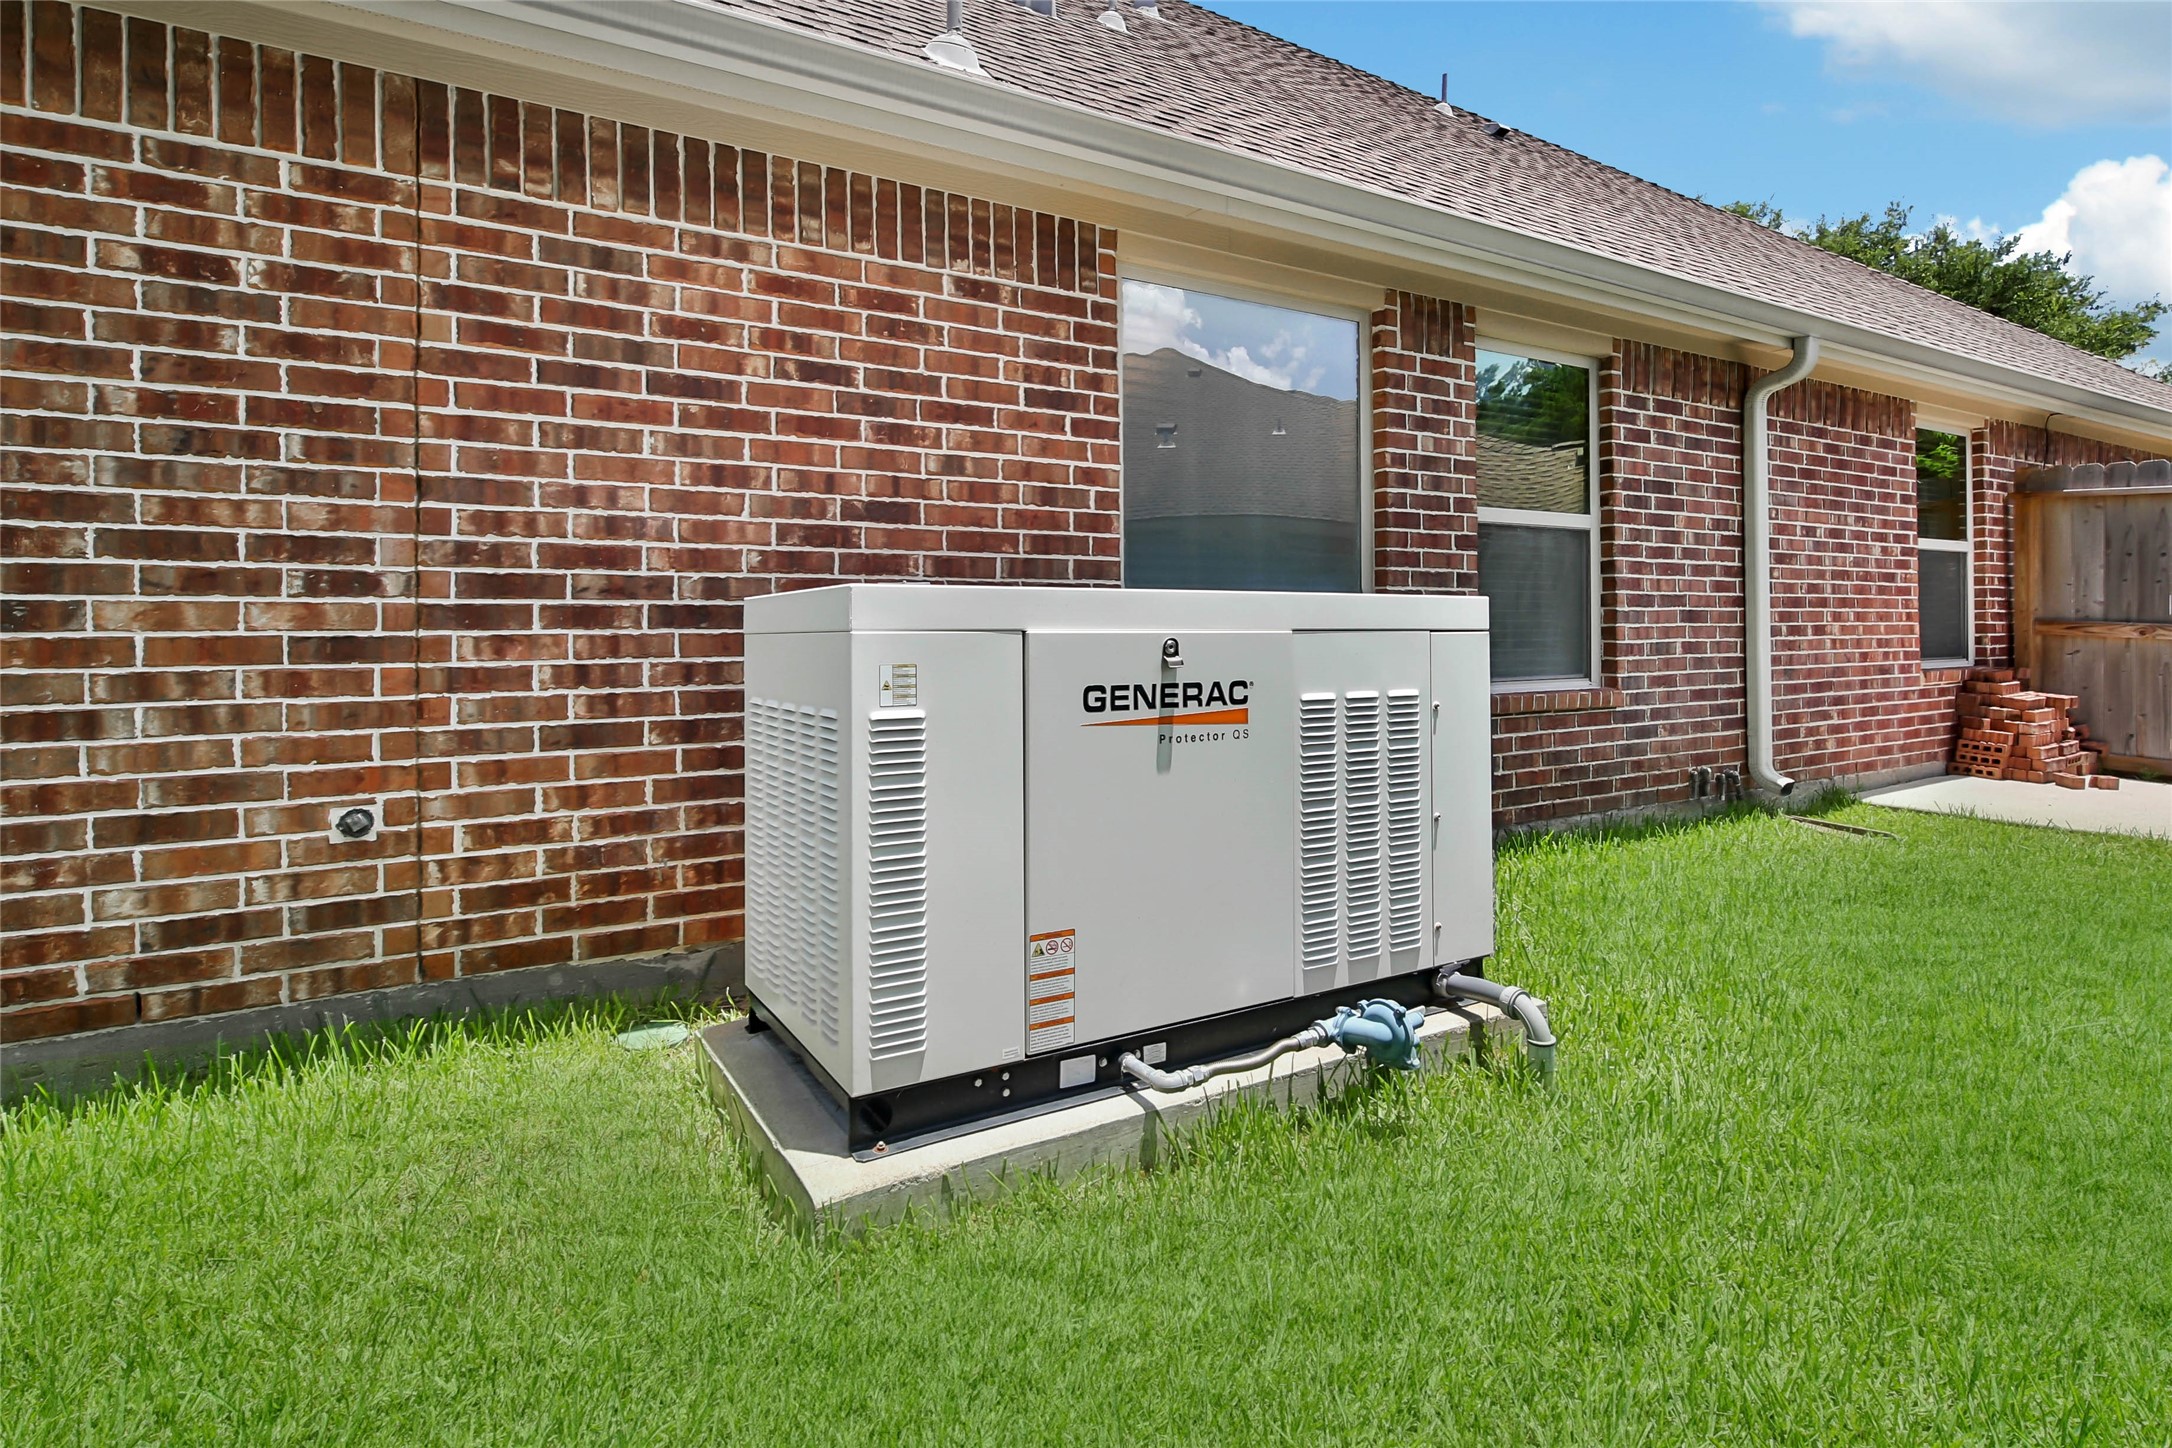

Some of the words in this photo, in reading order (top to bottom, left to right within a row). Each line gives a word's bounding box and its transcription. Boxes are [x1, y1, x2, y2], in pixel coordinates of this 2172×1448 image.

[1082, 680, 1249, 713] GENERAC
[1159, 731, 1226, 744] Protector
[1232, 729, 1249, 740] QS
